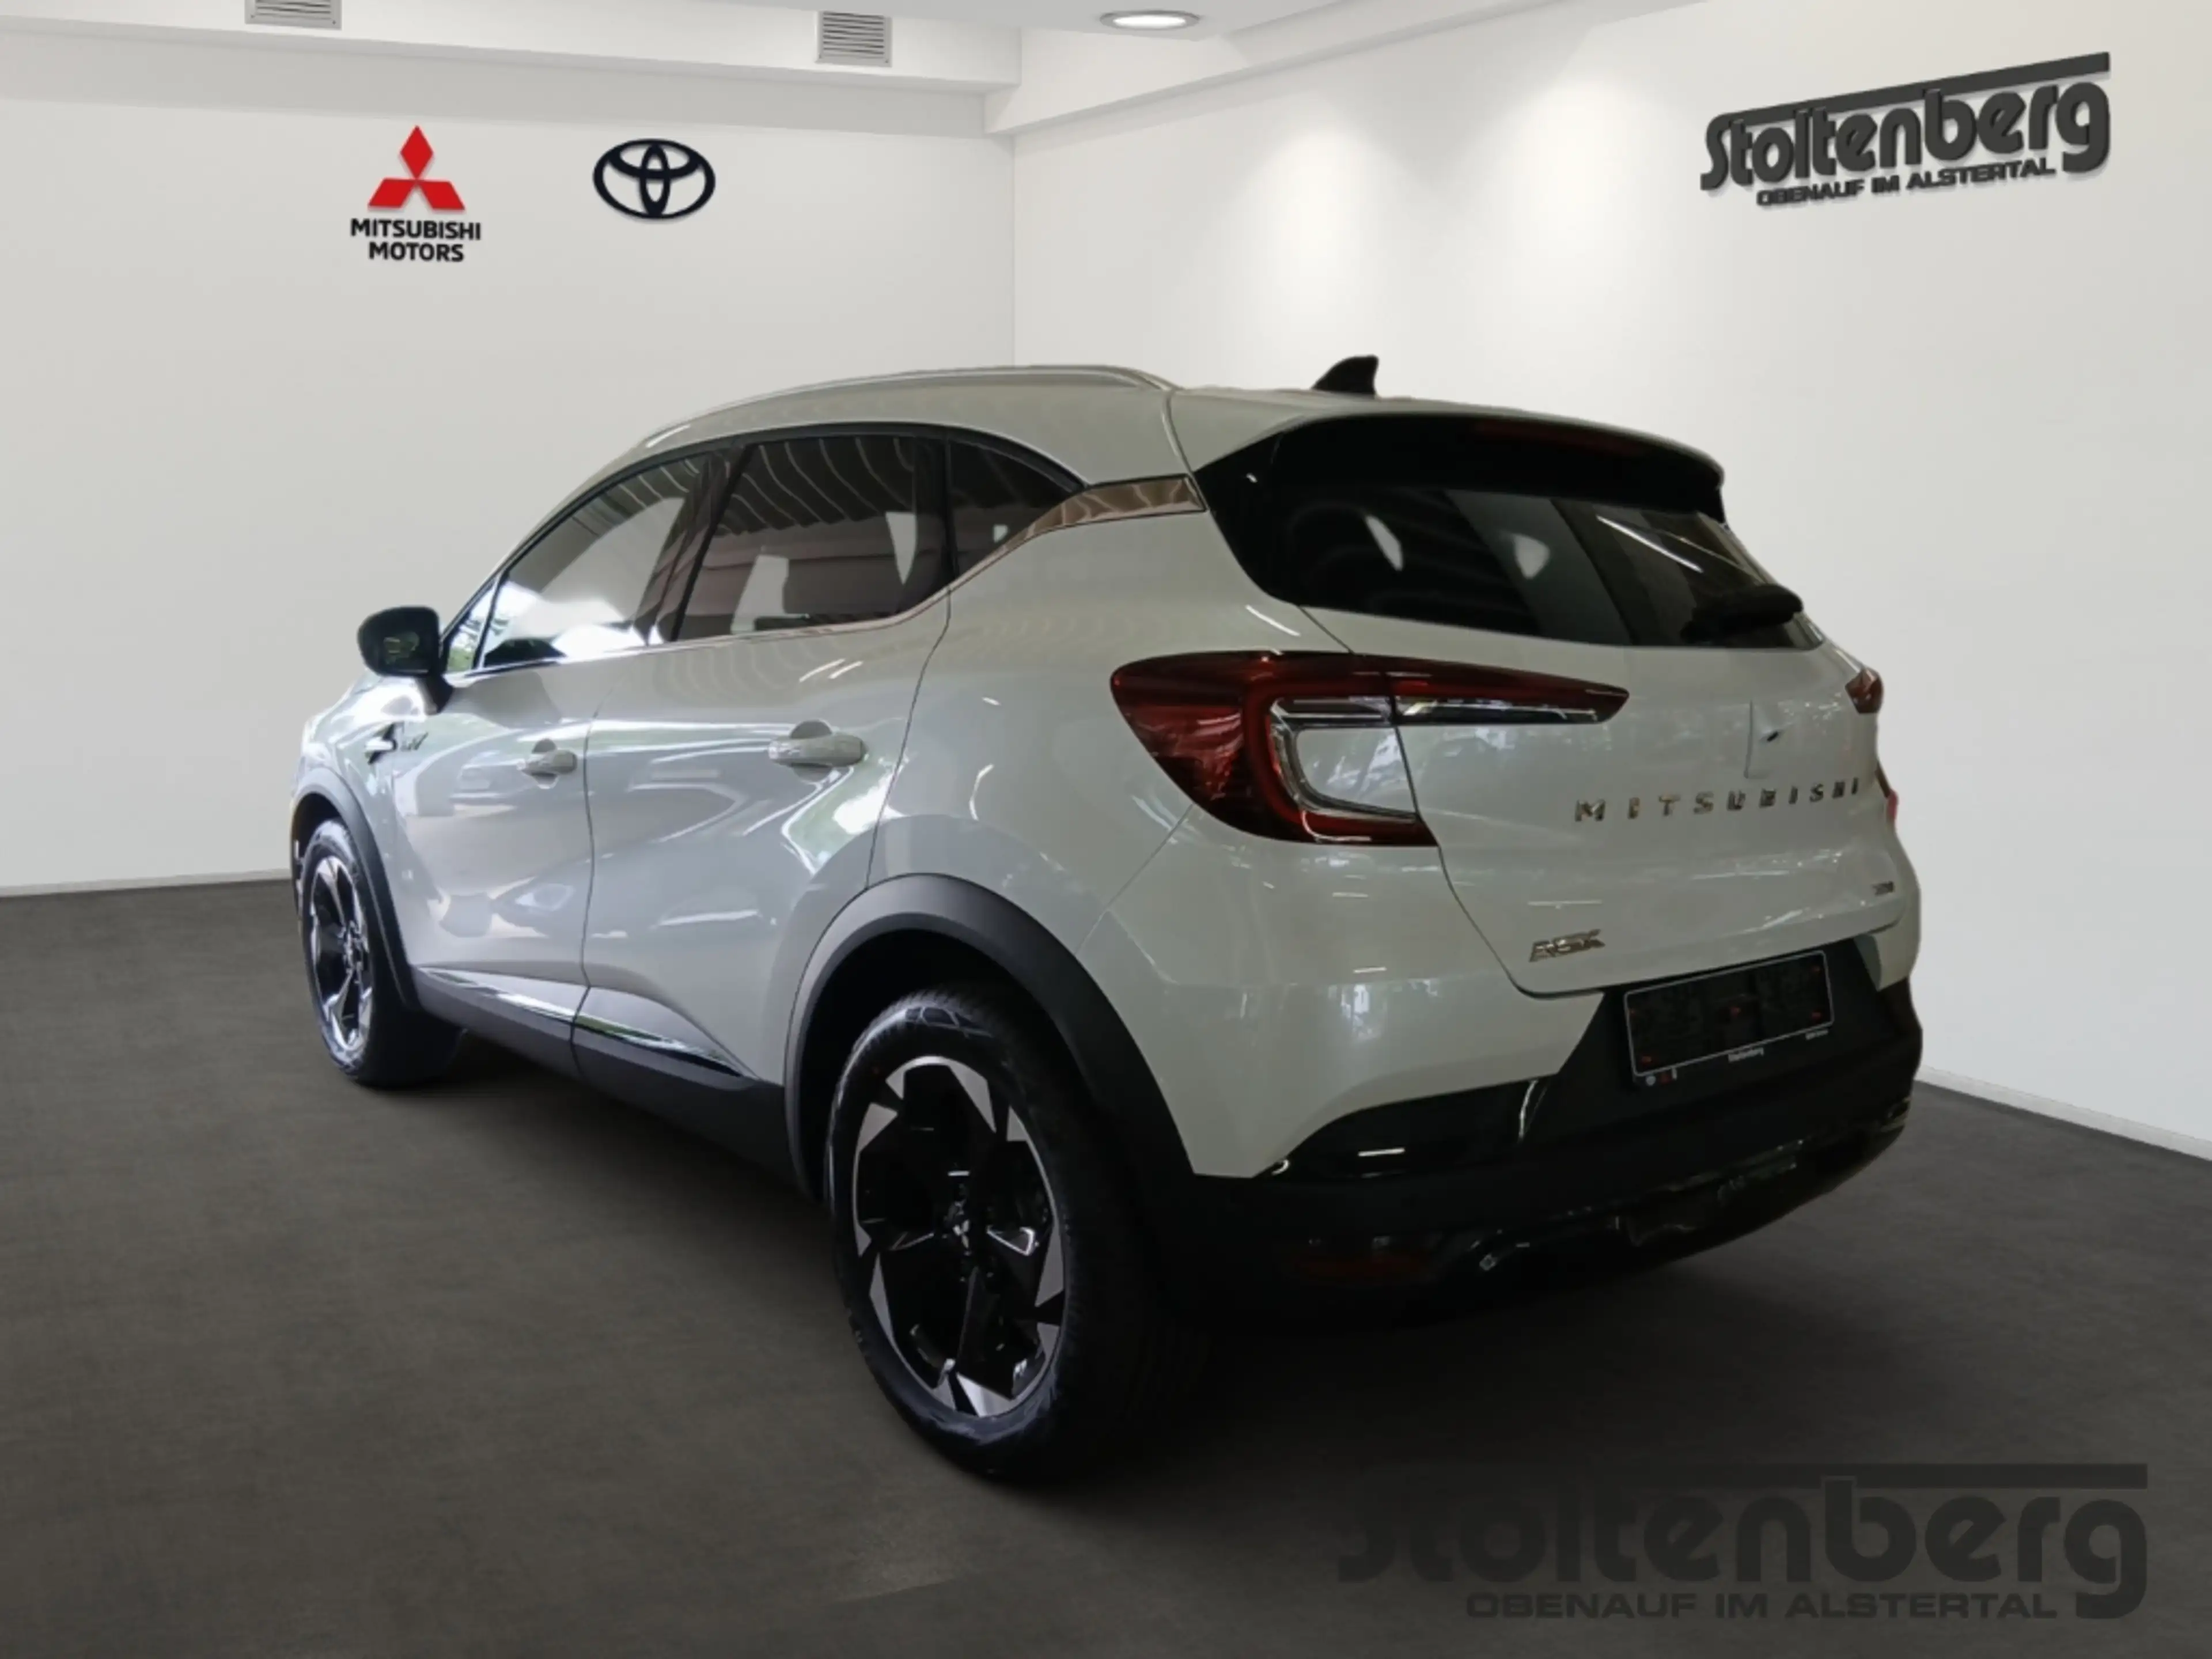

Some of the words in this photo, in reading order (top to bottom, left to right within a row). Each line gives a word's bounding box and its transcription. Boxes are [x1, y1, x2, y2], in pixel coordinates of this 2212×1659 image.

[1700, 52, 2110, 190] Stoltenberg
[1756, 179, 1865, 206] OBENAUF
[1872, 175, 1900, 194] IM
[1907, 157, 2056, 190] ALSTERTAL
[351, 218, 481, 240] MITSUBISHI
[369, 242, 464, 262] MOTORS
[1575, 777, 1859, 821] MITSUBISHI
